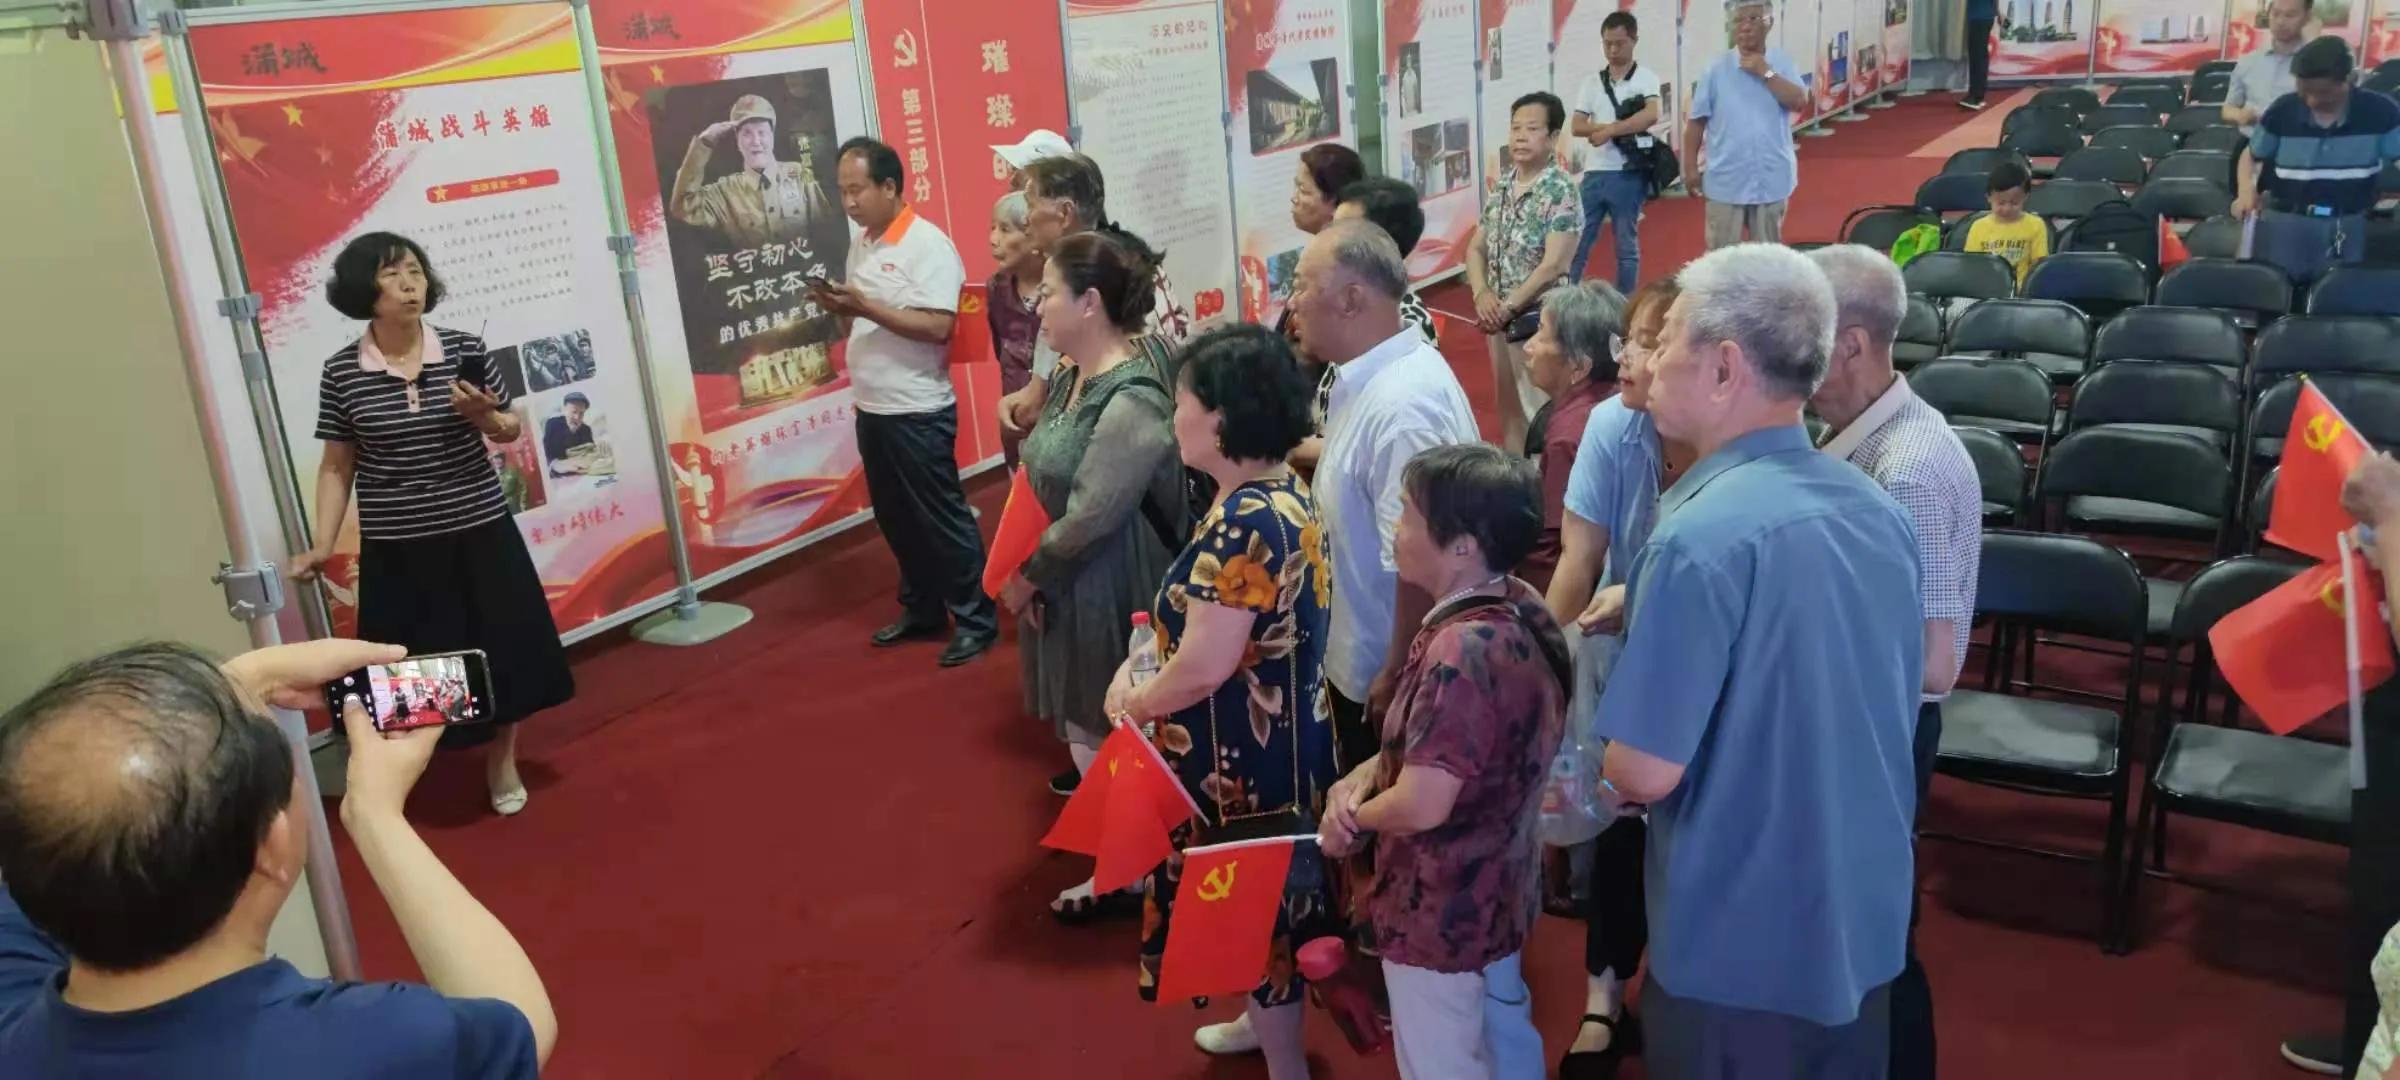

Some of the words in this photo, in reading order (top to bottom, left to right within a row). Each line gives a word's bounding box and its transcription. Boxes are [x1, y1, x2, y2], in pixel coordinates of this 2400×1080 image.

[240, 42, 328, 76] 蒲城
[375, 104, 552, 149] 蒲城战斗英雄
[901, 87, 932, 202] 第三部分
[705, 237, 814, 281] 坚守初心
[719, 302, 829, 344] 的优秀共产党
